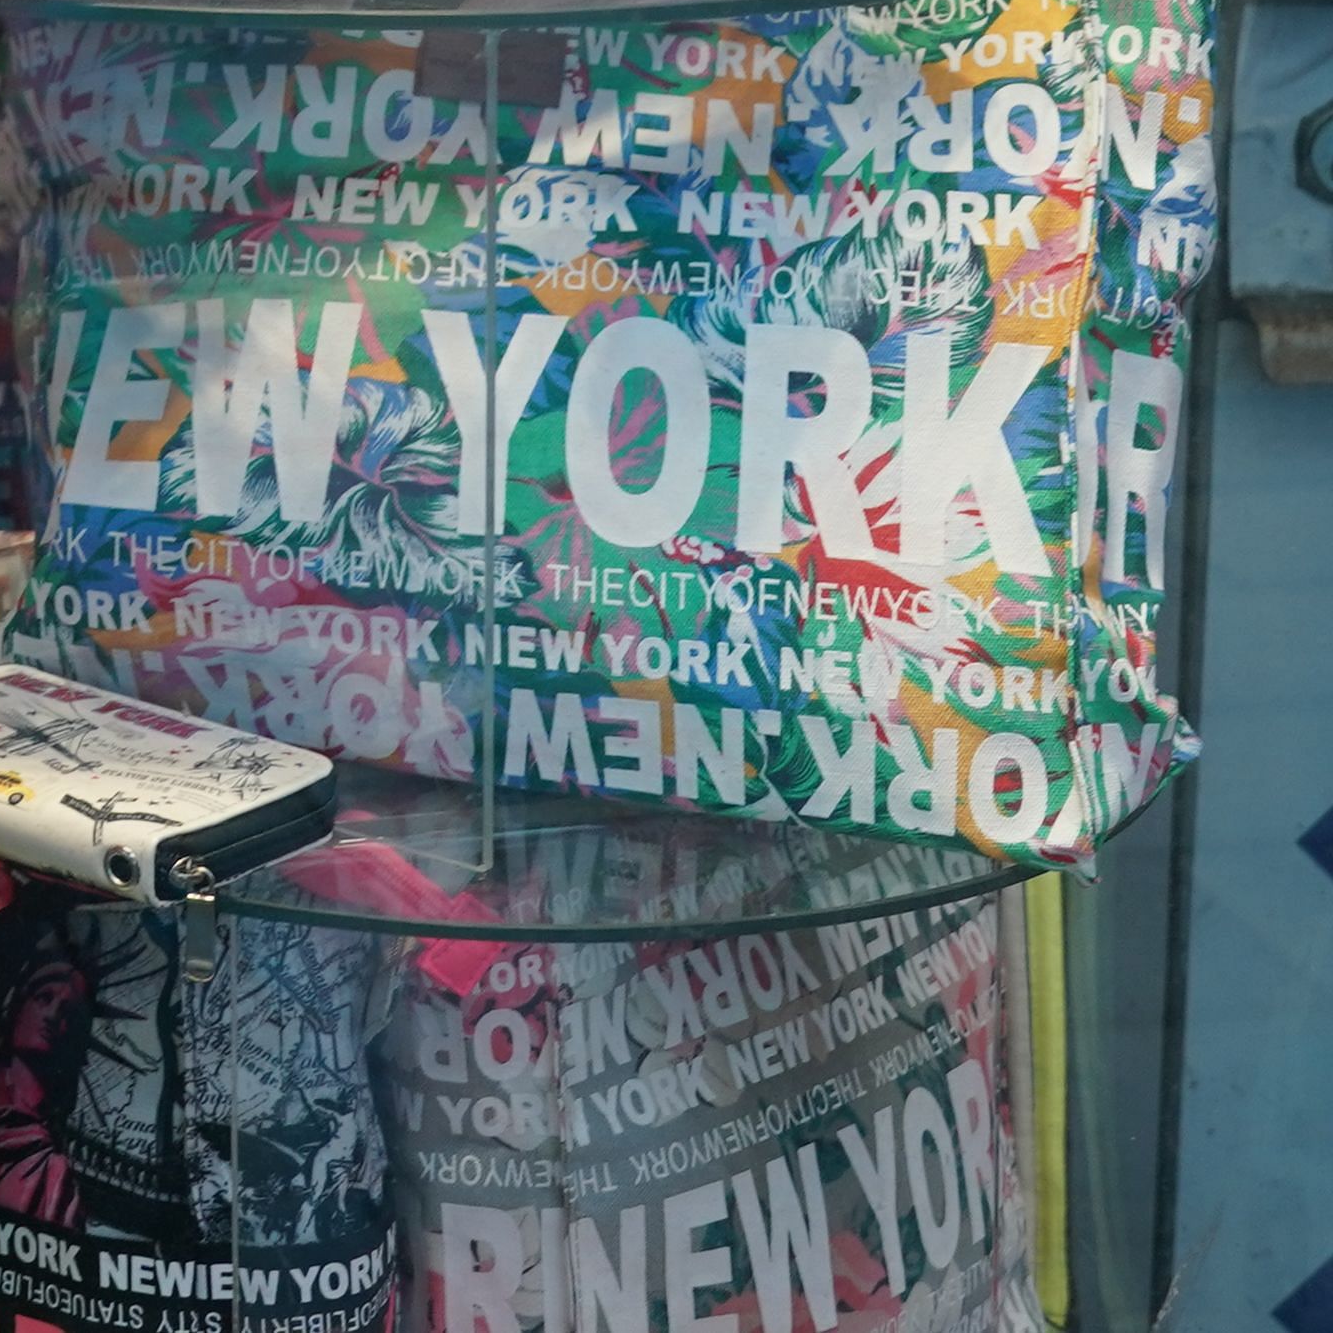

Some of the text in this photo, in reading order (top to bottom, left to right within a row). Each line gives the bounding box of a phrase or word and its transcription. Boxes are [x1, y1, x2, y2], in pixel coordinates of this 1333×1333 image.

[642, 30, 790, 85] YORK
[526, 85, 778, 178] NEW
[288, 172, 1046, 251] NEW YORK NEW YORK
[419, 309, 1053, 578] YORK
[107, 530, 1003, 636] THECITYOFNEWYORK THECITYOFNEWYORK
[33, 580, 1076, 718] YORK NEW YORK NEW YORK NEW YORK
[503, 685, 747, 806] NEW
[591, 1053, 719, 1137] YORK
[725, 1017, 813, 1090] NEW
[812, 974, 900, 1052] YORK
[98, 1251, 195, 1299] NEW
[289, 1240, 384, 1304] YORK
[568, 1141, 838, 1333] NEW
